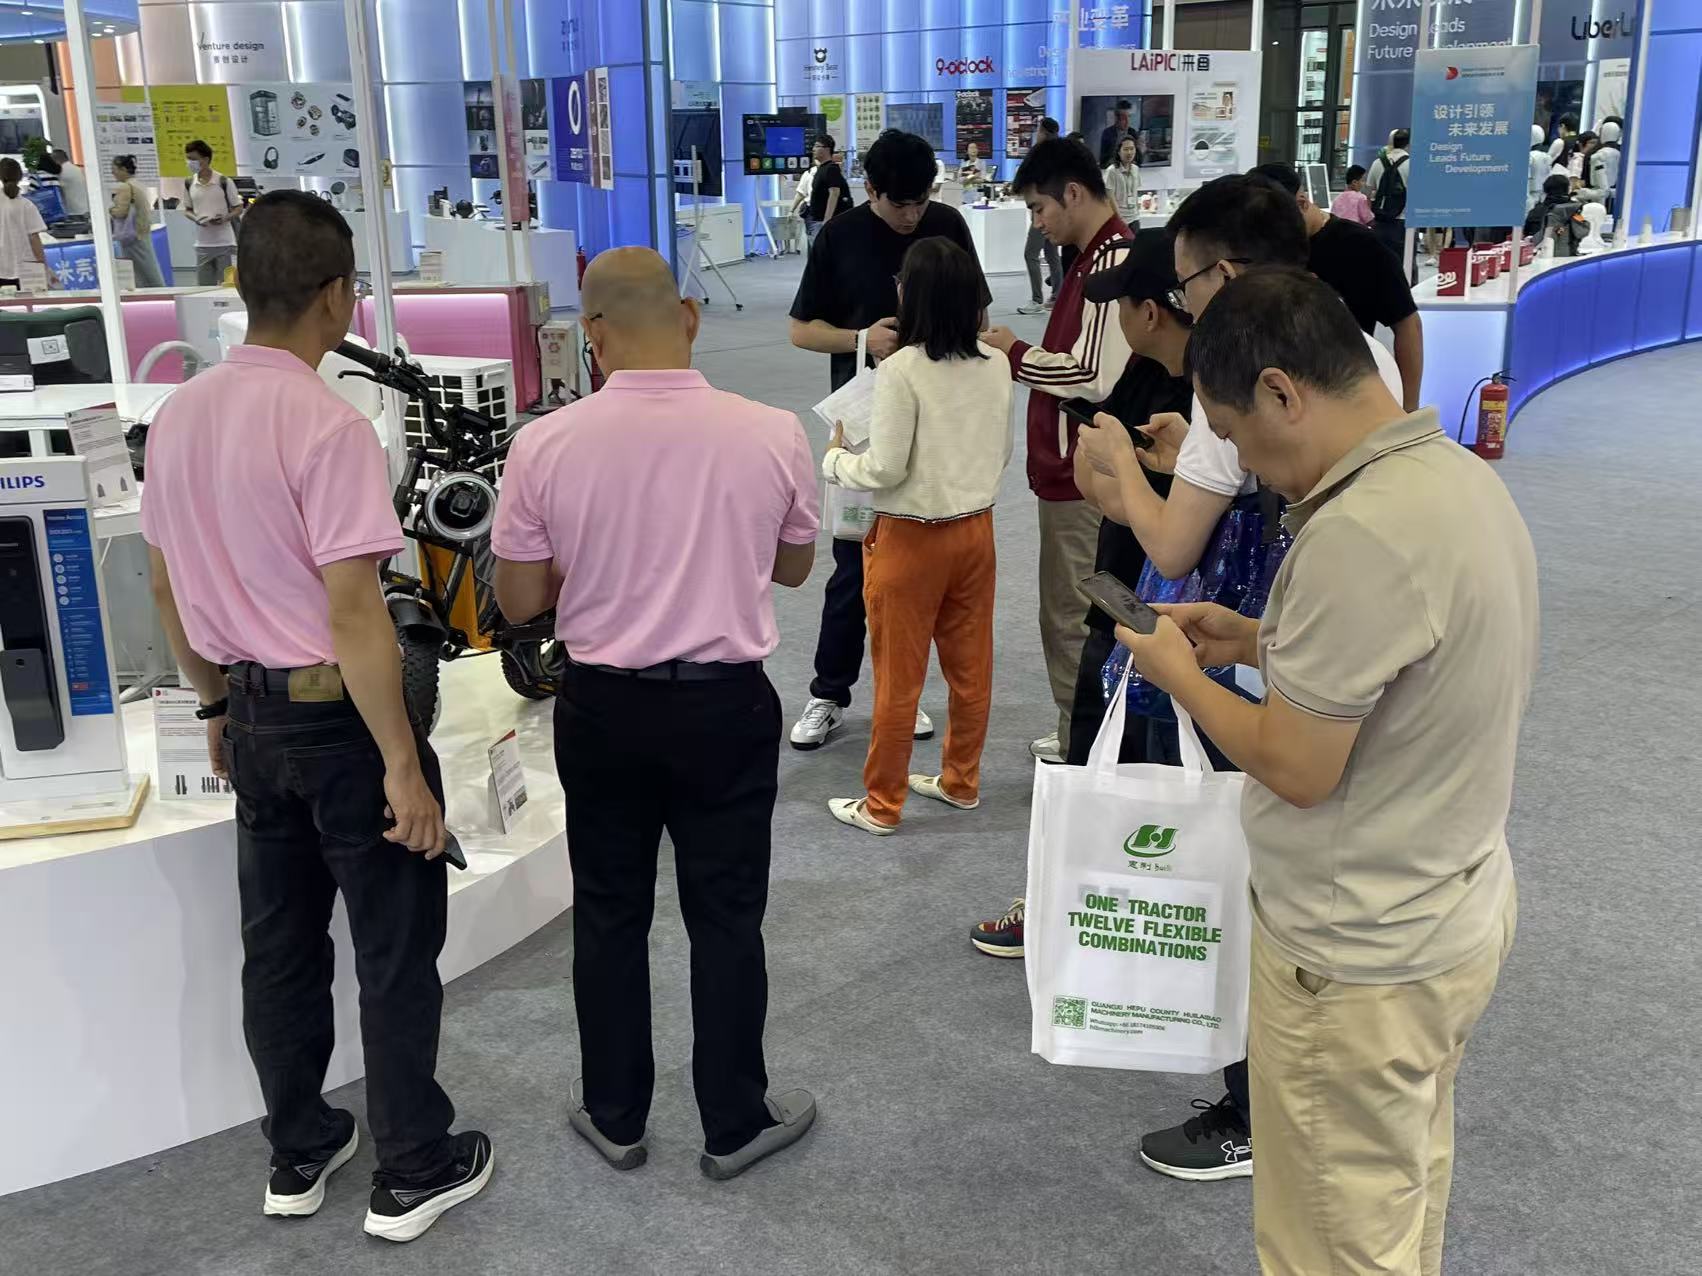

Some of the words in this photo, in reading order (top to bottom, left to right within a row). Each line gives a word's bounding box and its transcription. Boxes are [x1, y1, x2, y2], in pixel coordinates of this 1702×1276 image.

[1368, 21, 1418, 40] Design
[1428, 17, 1466, 34] eads
[233, 41, 265, 51] design
[1367, 44, 1413, 60] Future
[1434, 103, 1495, 120] 设计引领
[1448, 121, 1509, 137] 未来发展
[1430, 142, 1463, 153] Design
[1430, 153, 1457, 163] Leads
[1460, 152, 1492, 161] Future
[1445, 164, 1509, 175] Development
[54, 258, 97, 286] 米壳
[1085, 893, 1119, 913] ONE
[1128, 899, 1206, 923] TRACTOR
[1068, 911, 1135, 934] TWELVE
[1143, 920, 1222, 943] FLEXIBLE
[1078, 931, 1207, 961] COMBINATIONS
[1090, 1008, 1131, 1018] MACHINERY
[1131, 1013, 1192, 1024] MANUFACTURING
[1126, 1004, 1147, 1013] HEPU
[1150, 1007, 1180, 1017] COUNTY
